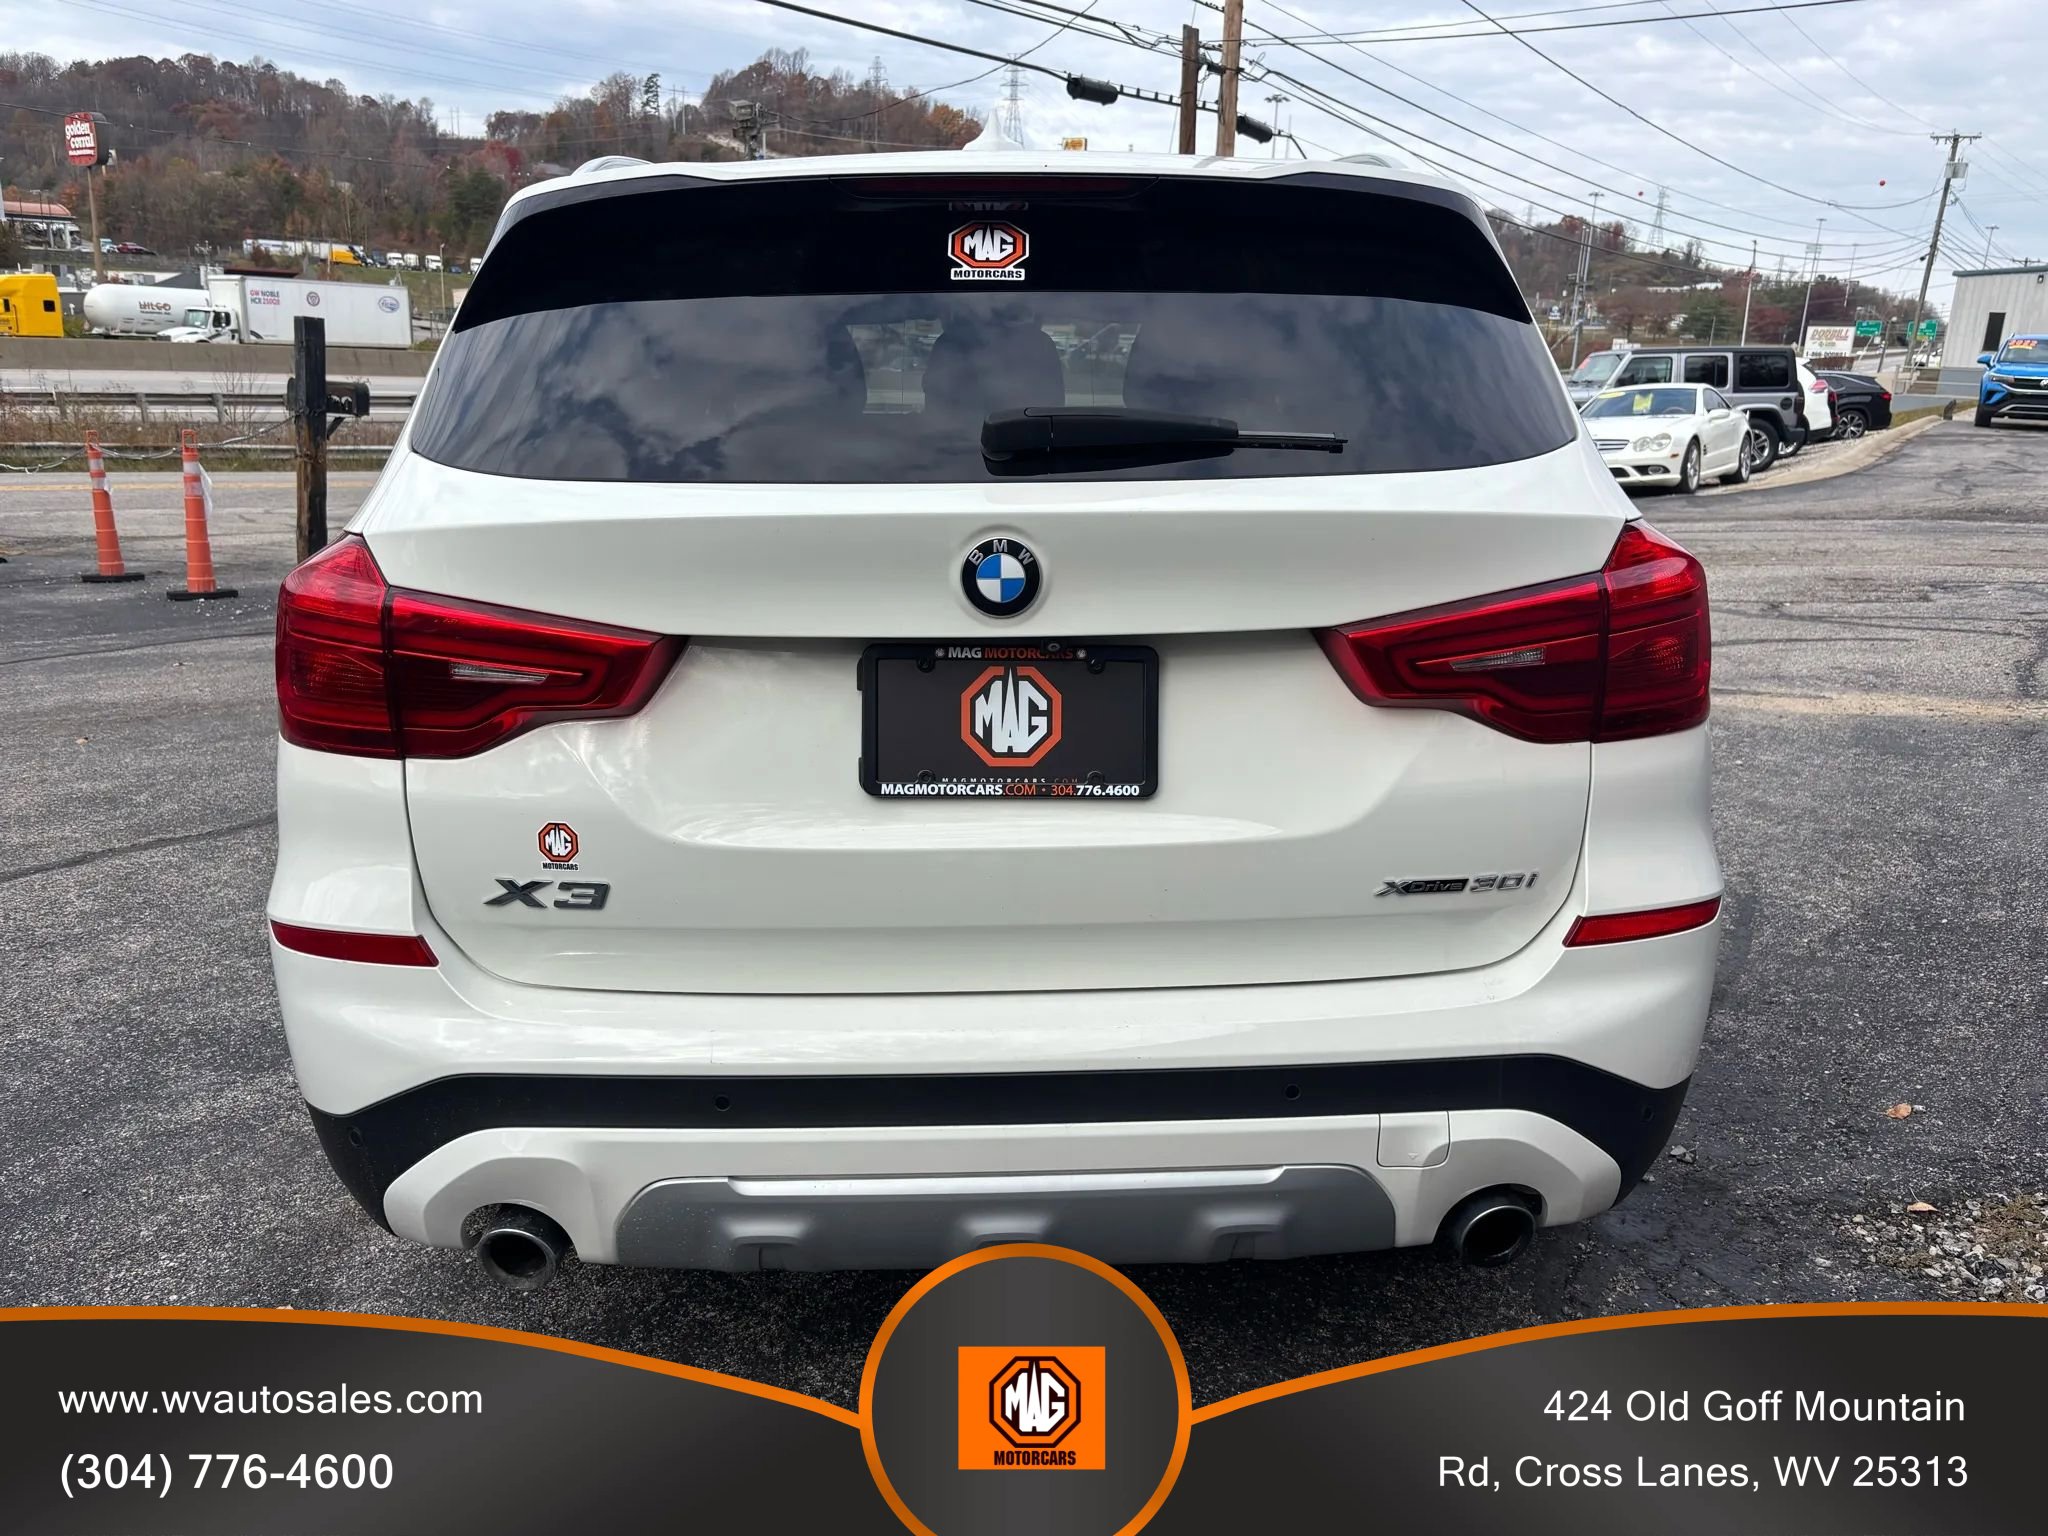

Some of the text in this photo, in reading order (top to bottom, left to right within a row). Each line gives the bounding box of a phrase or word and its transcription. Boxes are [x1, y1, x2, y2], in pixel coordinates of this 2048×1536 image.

[65, 119, 90, 140] golden
[70, 133, 95, 149] corral
[963, 225, 1014, 261] MAG
[953, 269, 1022, 279] MOTORCARS
[968, 539, 1034, 566] BMW
[948, 647, 982, 659] MAG
[974, 667, 1048, 753] MAG
[880, 783, 1140, 797] MAGMOTORCARS.COM 304.776.4600
[544, 823, 572, 857] MAG
[542, 862, 579, 871] MOTORCARS
[482, 877, 611, 911] X3
